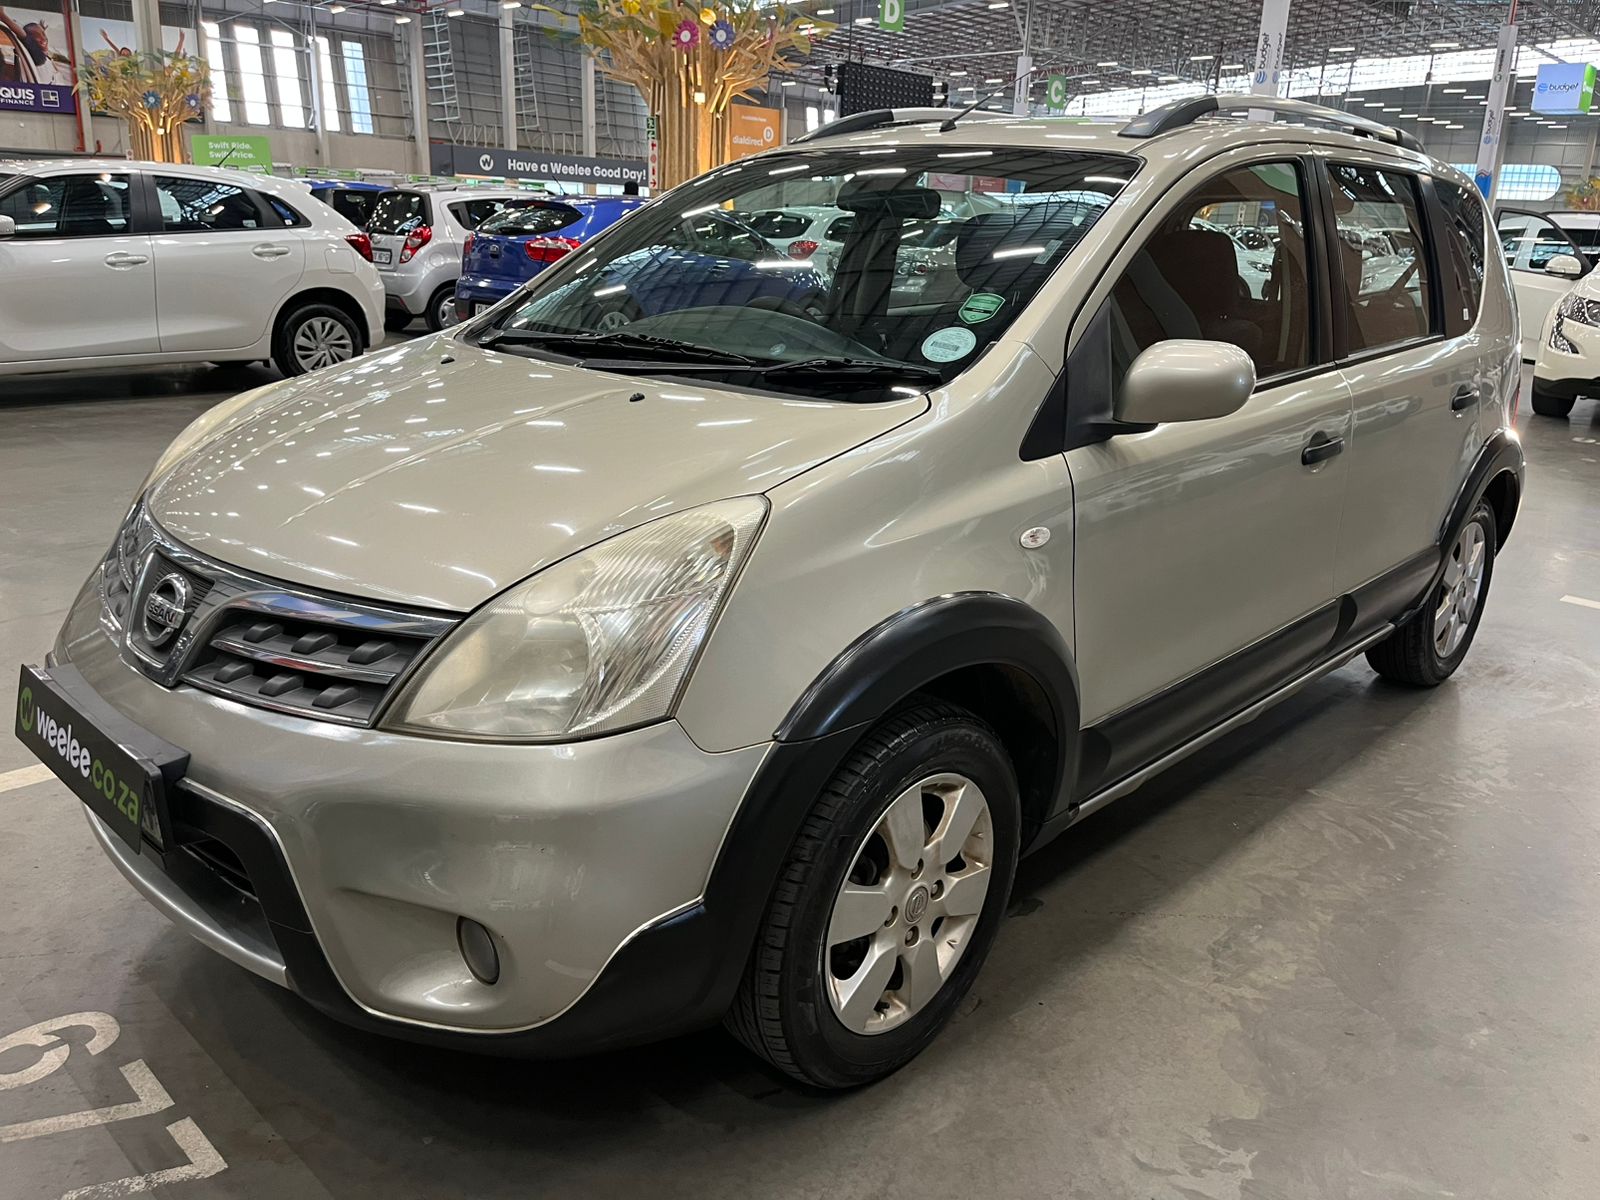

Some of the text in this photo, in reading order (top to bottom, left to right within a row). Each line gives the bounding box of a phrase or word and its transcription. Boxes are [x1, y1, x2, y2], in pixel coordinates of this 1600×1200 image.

[884, 0, 900, 23] D
[1259, 32, 1271, 69] budget
[1051, 81, 1063, 104] C
[1549, 82, 1579, 93] budget
[507, 158, 647, 183] Have a Weelee Good Day!
